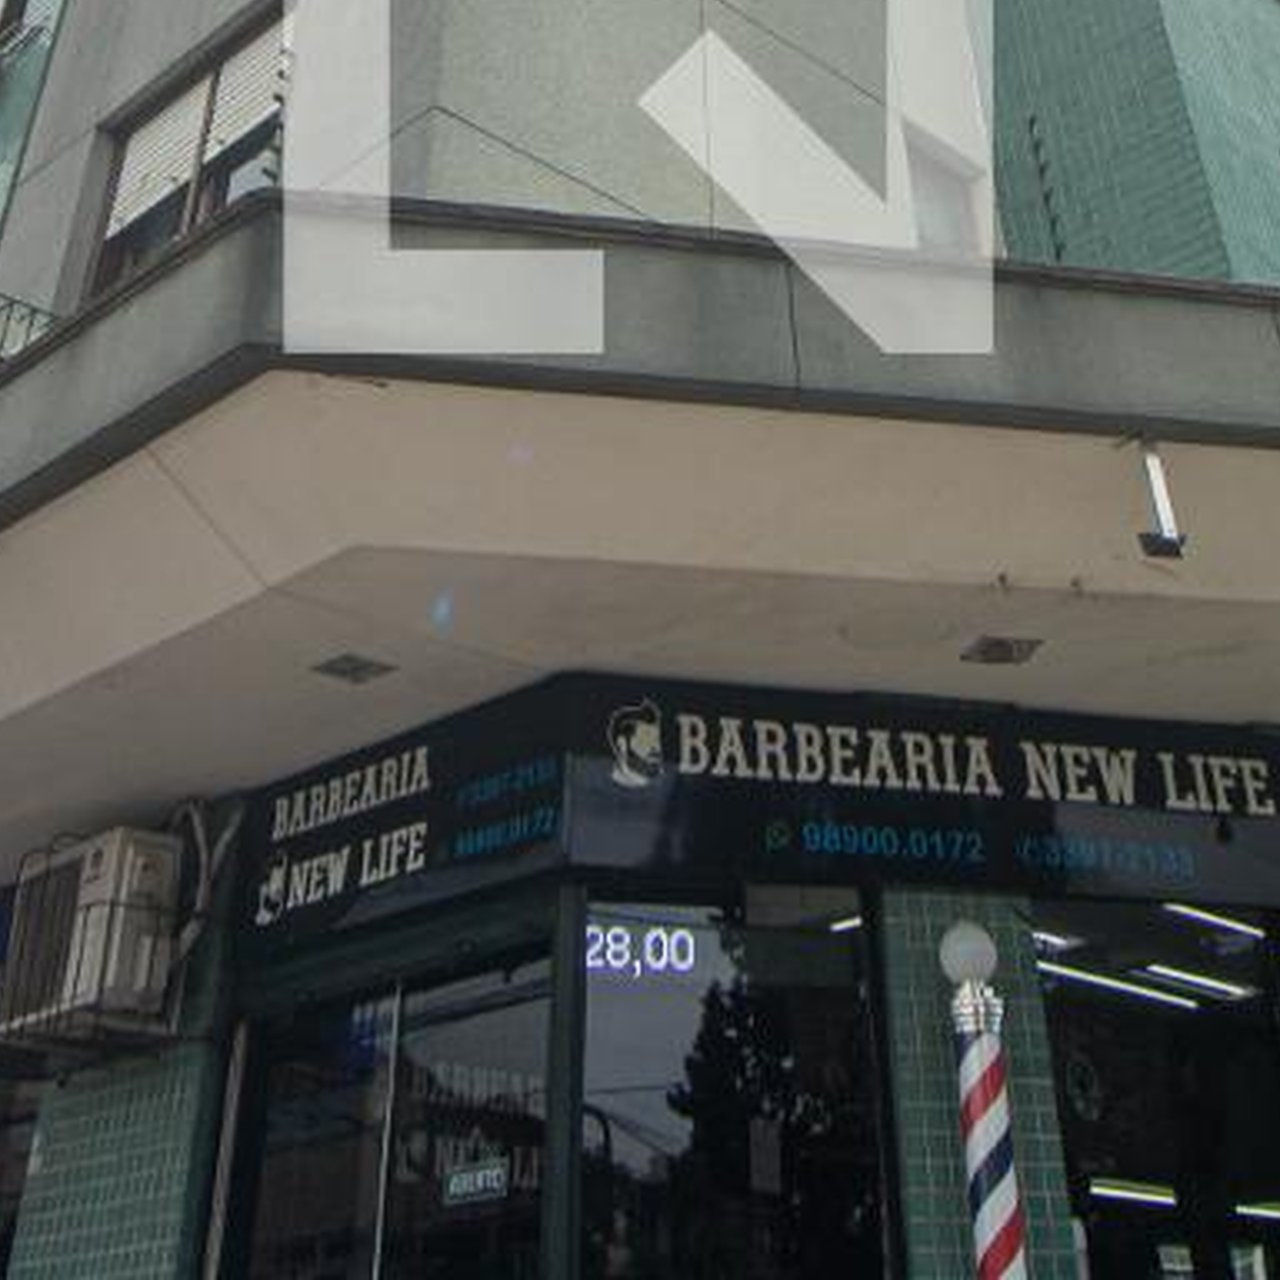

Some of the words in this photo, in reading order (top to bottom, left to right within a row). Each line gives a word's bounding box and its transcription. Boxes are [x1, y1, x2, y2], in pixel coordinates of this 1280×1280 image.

[272, 746, 430, 841] BARBEARIA
[677, 714, 1003, 797] BARBEARIA
[1021, 740, 1138, 807] NEW
[1158, 752, 1277, 818] LIFE
[287, 847, 351, 909] NEW
[358, 821, 428, 887] LIFE
[801, 823, 984, 861] 98900.0172
[585, 925, 695, 979] 28,00
